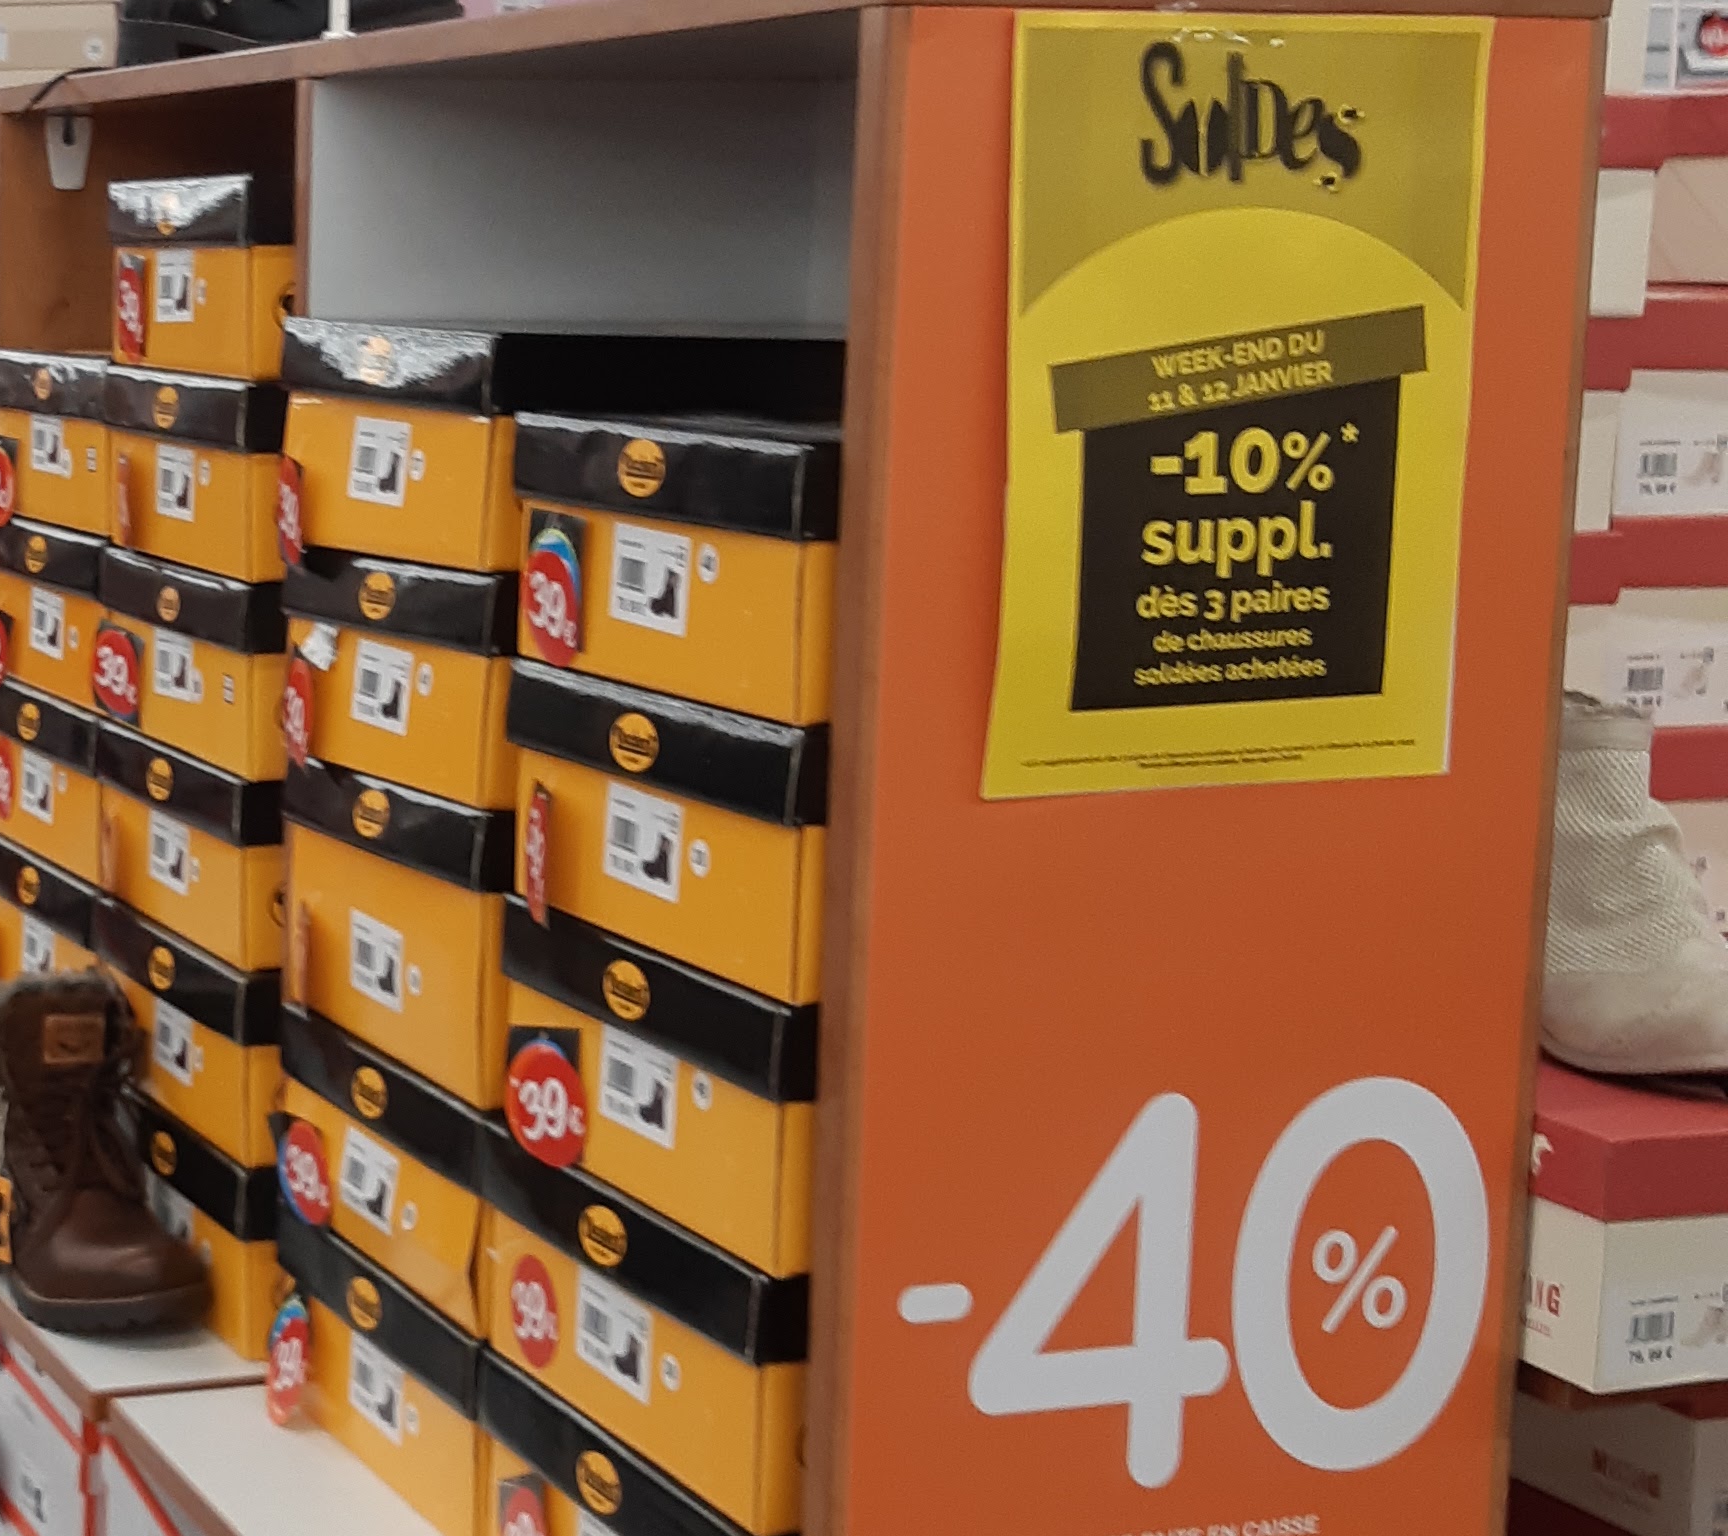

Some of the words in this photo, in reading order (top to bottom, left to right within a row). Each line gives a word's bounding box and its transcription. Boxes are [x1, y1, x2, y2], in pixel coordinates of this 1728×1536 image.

[1151, 336, 1284, 380] WEEK-END
[1288, 330, 1325, 358] DU
[1232, 360, 1333, 398] JANVIER
[1141, 499, 1333, 579] suppl.
[1136, 585, 1200, 619] dès
[1203, 588, 1226, 622] 3
[1229, 579, 1331, 623] paires
[1152, 629, 1185, 654] de
[1186, 628, 1314, 652] chaussures
